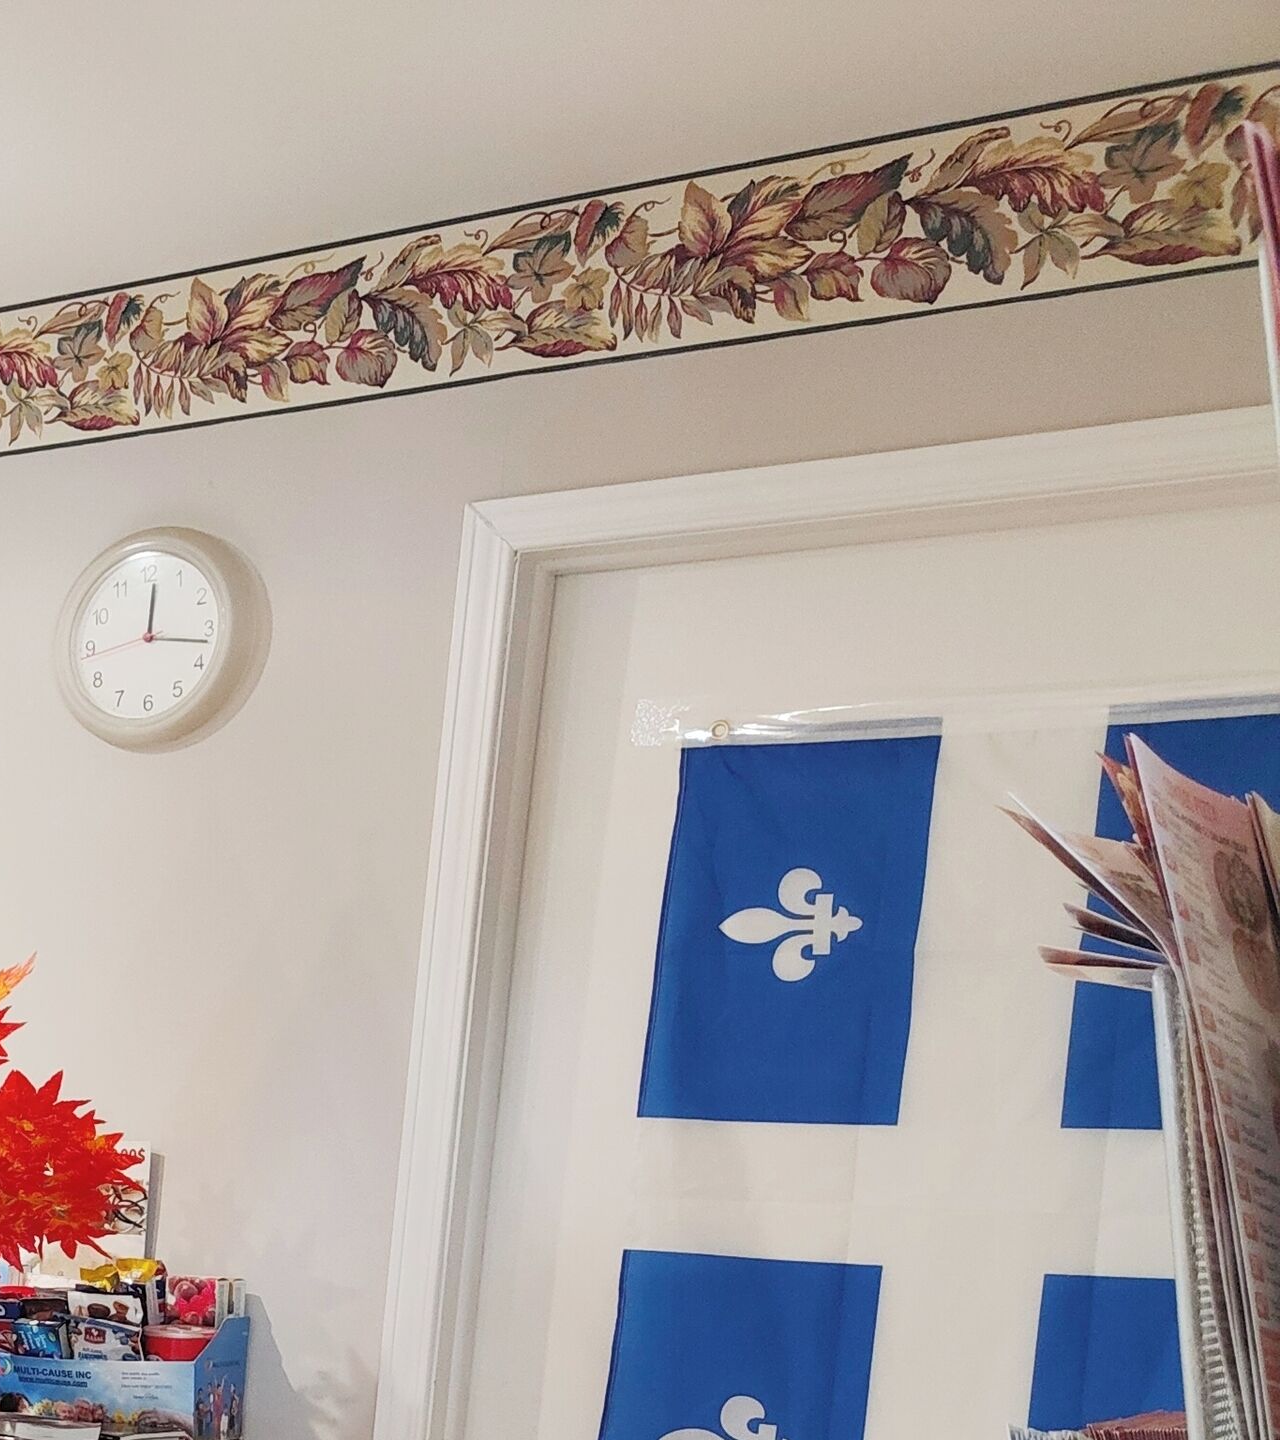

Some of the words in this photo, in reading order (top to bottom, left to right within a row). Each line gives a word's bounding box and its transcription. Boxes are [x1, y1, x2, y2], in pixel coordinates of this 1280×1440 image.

[141, 565, 157, 583] 12
[176, 570, 183, 586] 1
[113, 580, 128, 597] 11
[197, 588, 207, 605] 2
[92, 608, 109, 625] 10
[204, 620, 214, 637] 3
[86, 641, 96, 658] 9
[194, 654, 204, 670] 4
[93, 672, 103, 688] 8
[172, 681, 183, 698] 5
[115, 690, 124, 707] 7
[143, 695, 154, 711] 6
[13, 1365, 73, 1379] MULTI-CAUSE
[75, 1371, 92, 1380] INC
